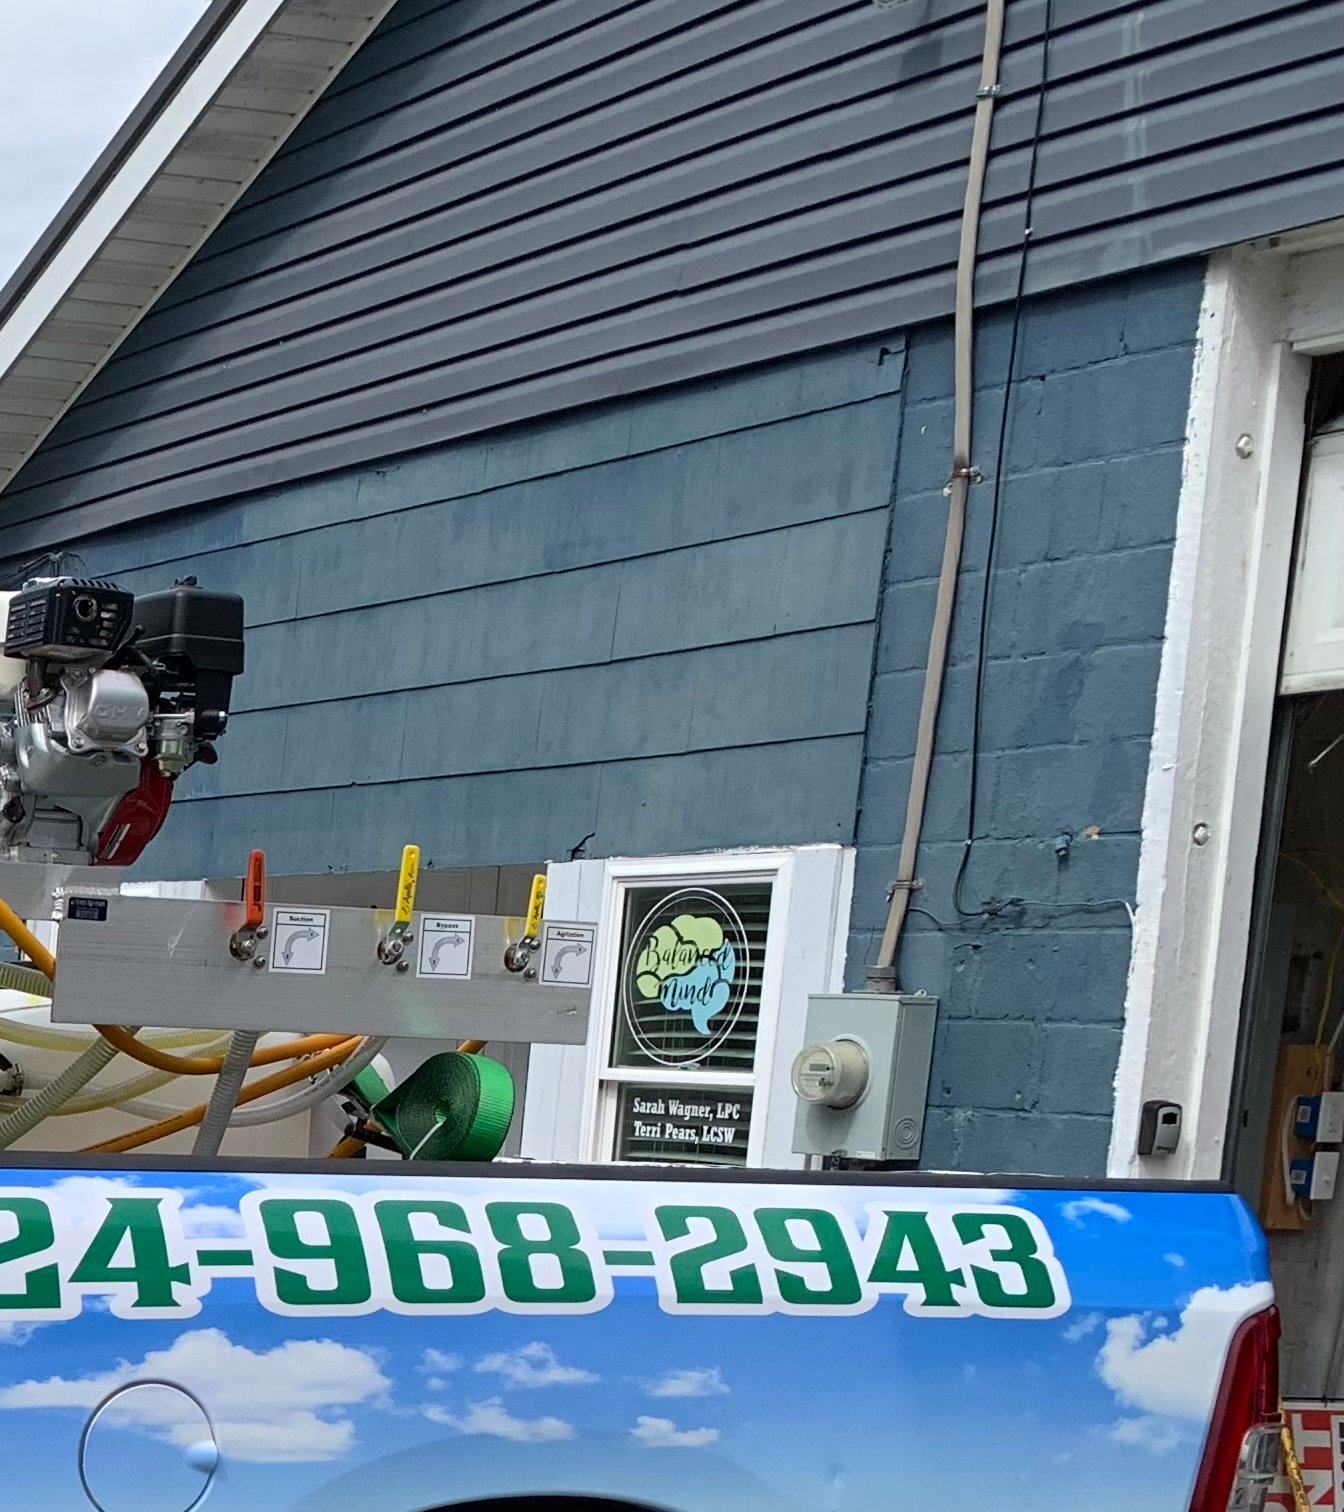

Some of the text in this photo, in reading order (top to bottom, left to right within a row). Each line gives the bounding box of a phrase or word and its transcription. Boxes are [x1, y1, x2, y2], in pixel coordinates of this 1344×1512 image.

[288, 914, 315, 924] Suction
[436, 921, 460, 931] Bypass
[556, 930, 585, 940] Agitation
[653, 977, 713, 1008] Mind
[632, 1097, 741, 1122] Sarah Wagner, LPC
[634, 1120, 736, 1145] Terri Pears, LCSW
